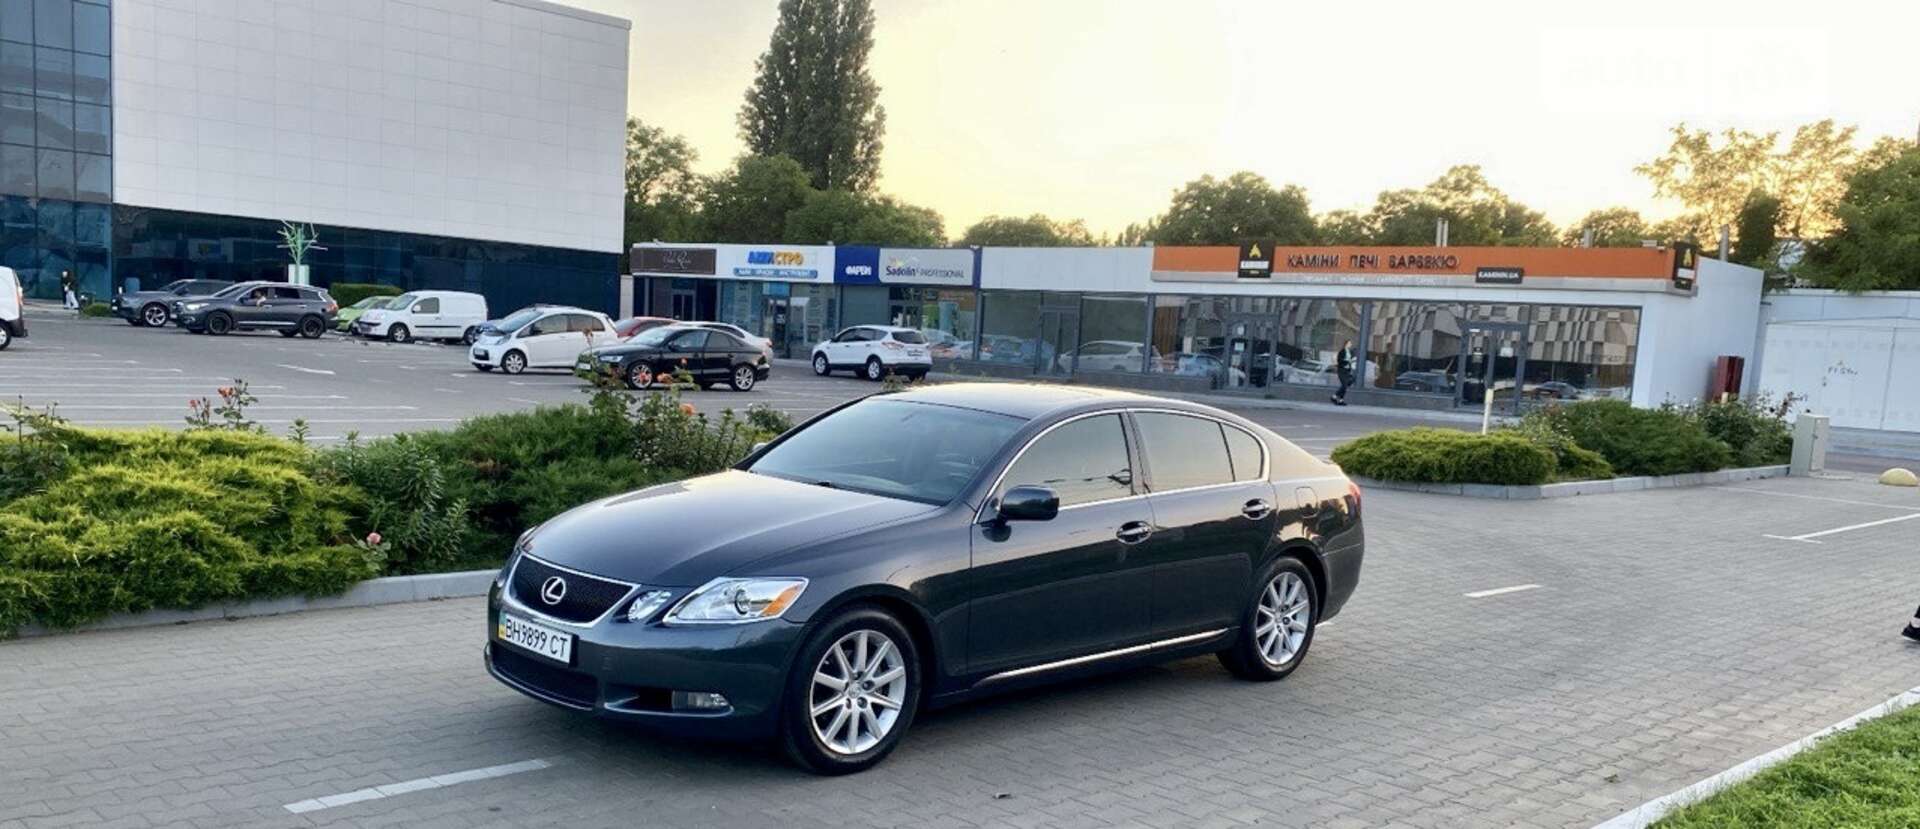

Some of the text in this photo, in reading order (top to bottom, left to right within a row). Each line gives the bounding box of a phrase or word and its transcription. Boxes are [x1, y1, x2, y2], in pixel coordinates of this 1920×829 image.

[1287, 254, 1340, 268] КАМІНИ
[1350, 255, 1378, 269] ПЕЧІ
[550, 634, 568, 658] CT
